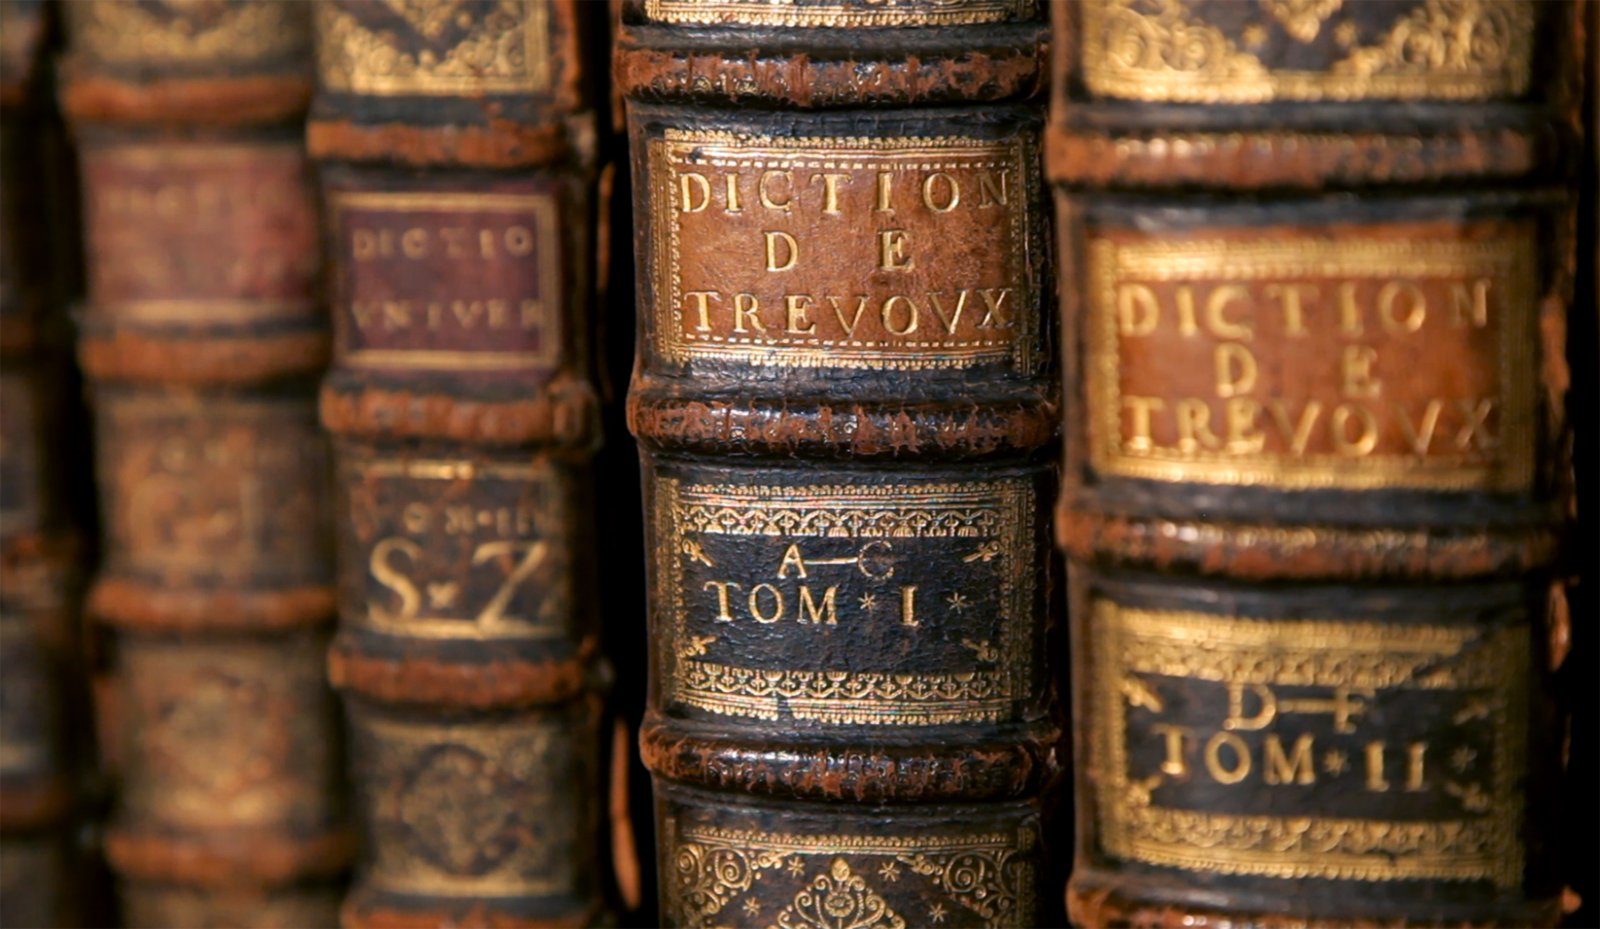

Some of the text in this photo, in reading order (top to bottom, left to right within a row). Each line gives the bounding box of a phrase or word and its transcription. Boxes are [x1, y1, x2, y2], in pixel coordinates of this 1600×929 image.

[679, 168, 1009, 215] DICTION
[684, 287, 1014, 337] TREVOVX
[1118, 278, 1491, 339] DICTION
[703, 580, 839, 625] TOM
[1151, 724, 1316, 786] TOM
